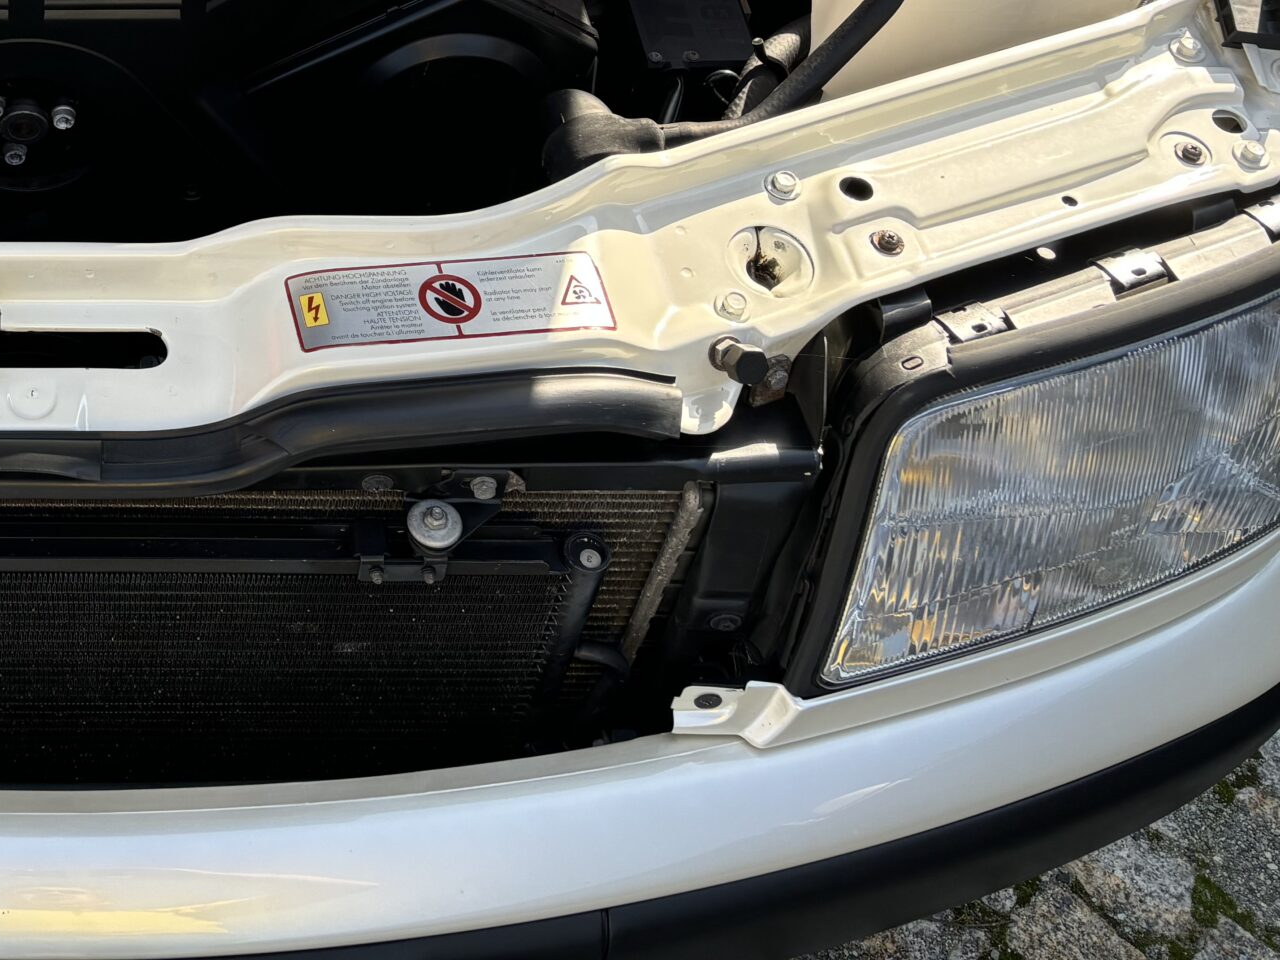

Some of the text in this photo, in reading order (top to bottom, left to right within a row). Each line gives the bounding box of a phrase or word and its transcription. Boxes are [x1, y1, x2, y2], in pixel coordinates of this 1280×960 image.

[304, 270, 407, 283] ACHTUNG HOCHSPANNUNG
[331, 293, 362, 301] DANGER
